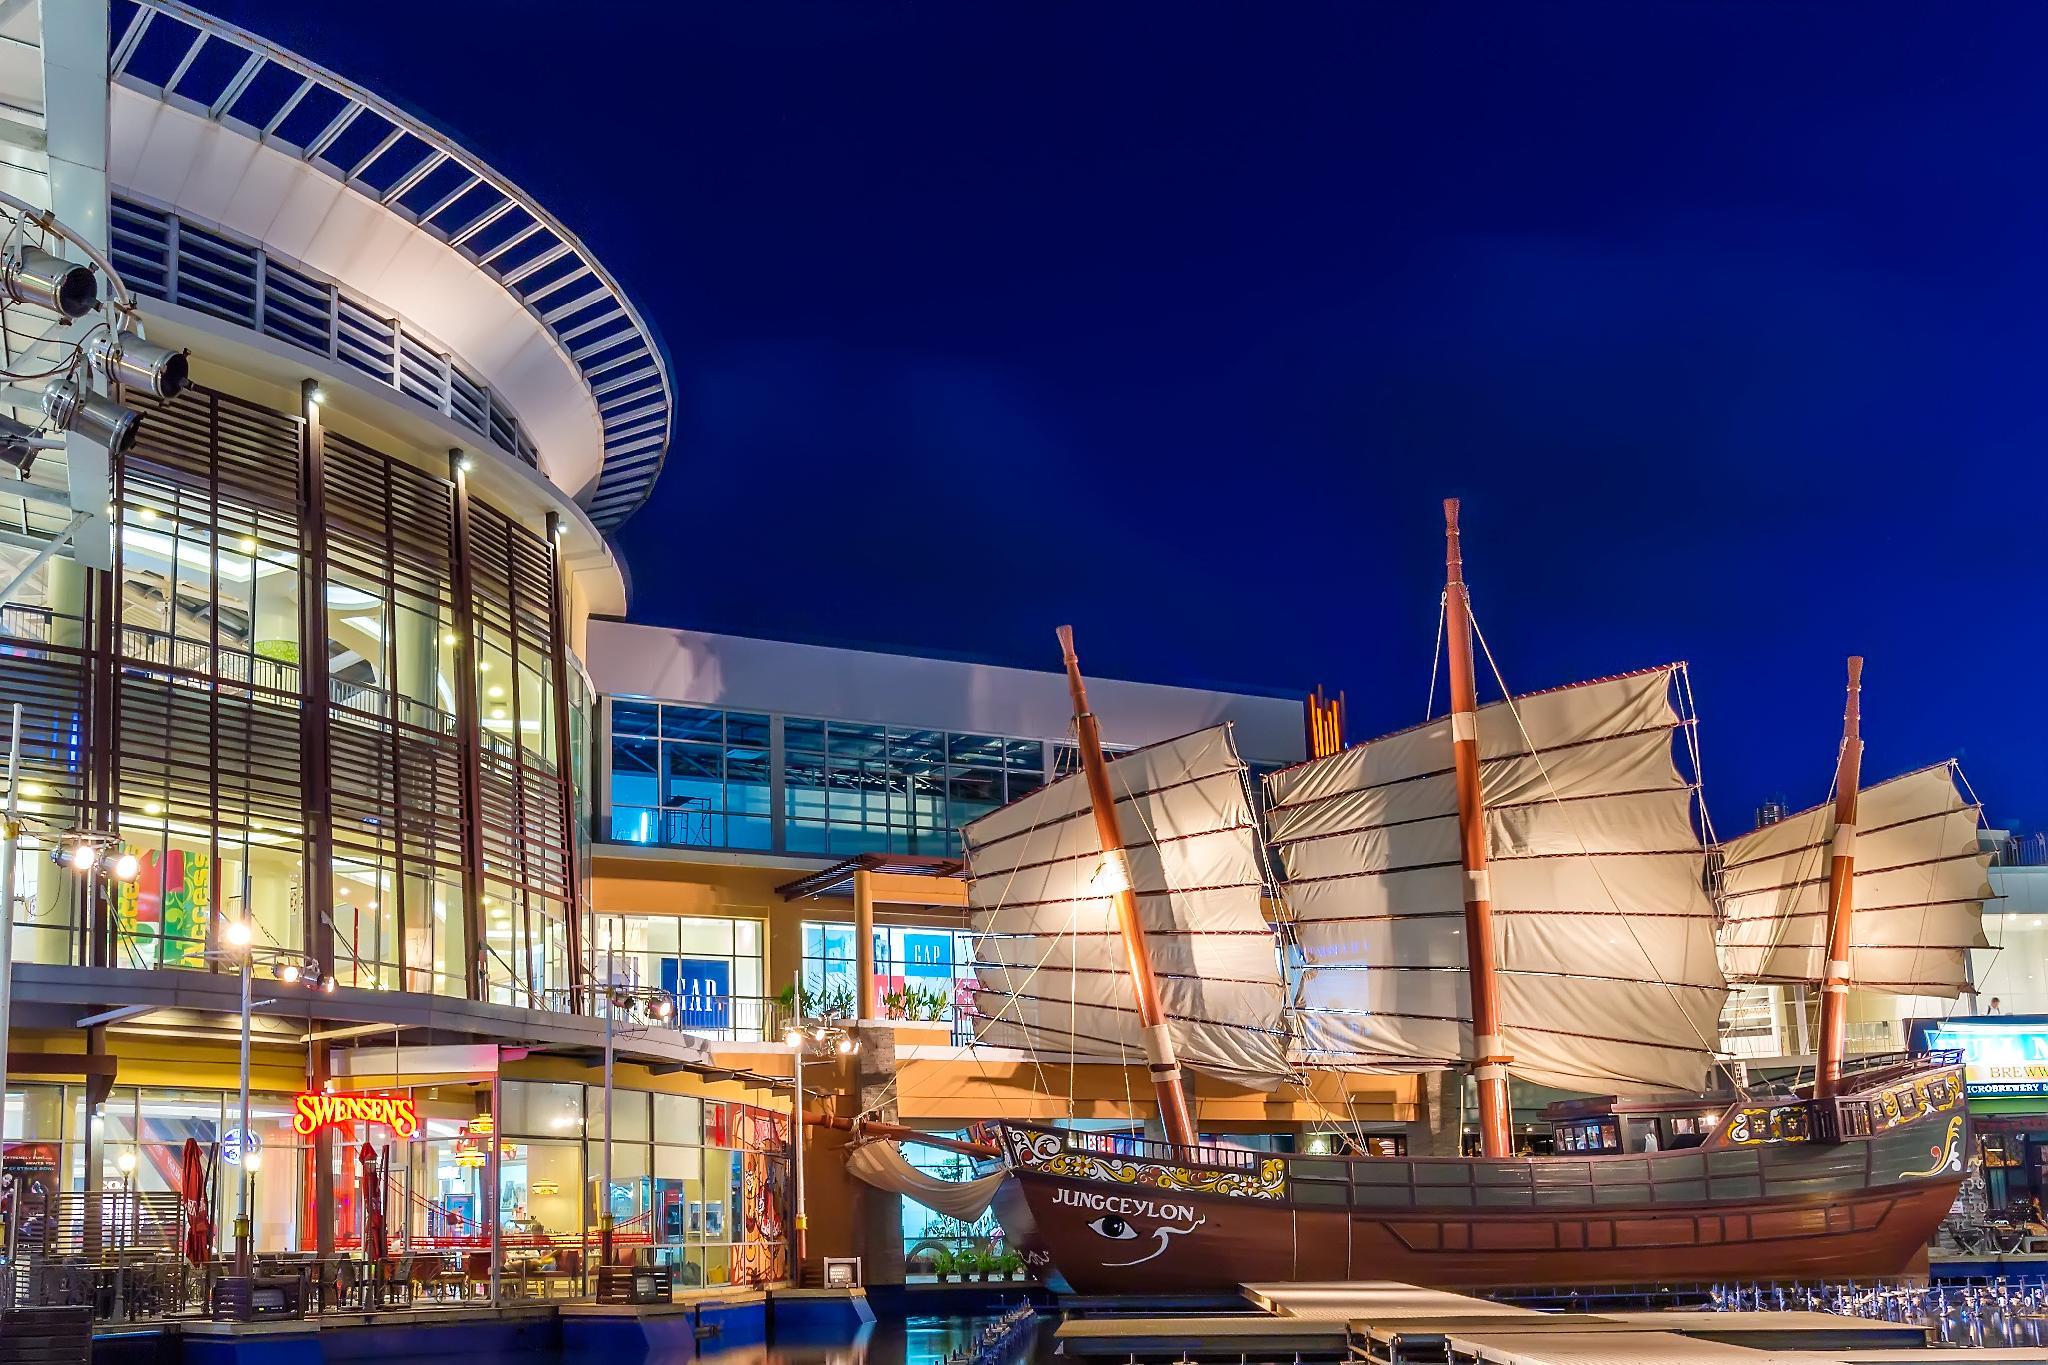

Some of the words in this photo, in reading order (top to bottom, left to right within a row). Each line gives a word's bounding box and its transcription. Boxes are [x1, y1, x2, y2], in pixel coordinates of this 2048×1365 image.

[181, 852, 209, 968] Access
[913, 944, 941, 967] GAP
[676, 978, 717, 1012] GAP
[1966, 1084, 2040, 1093] ICROBREWERY
[1052, 1188, 1195, 1222] JUNGCEYLON
